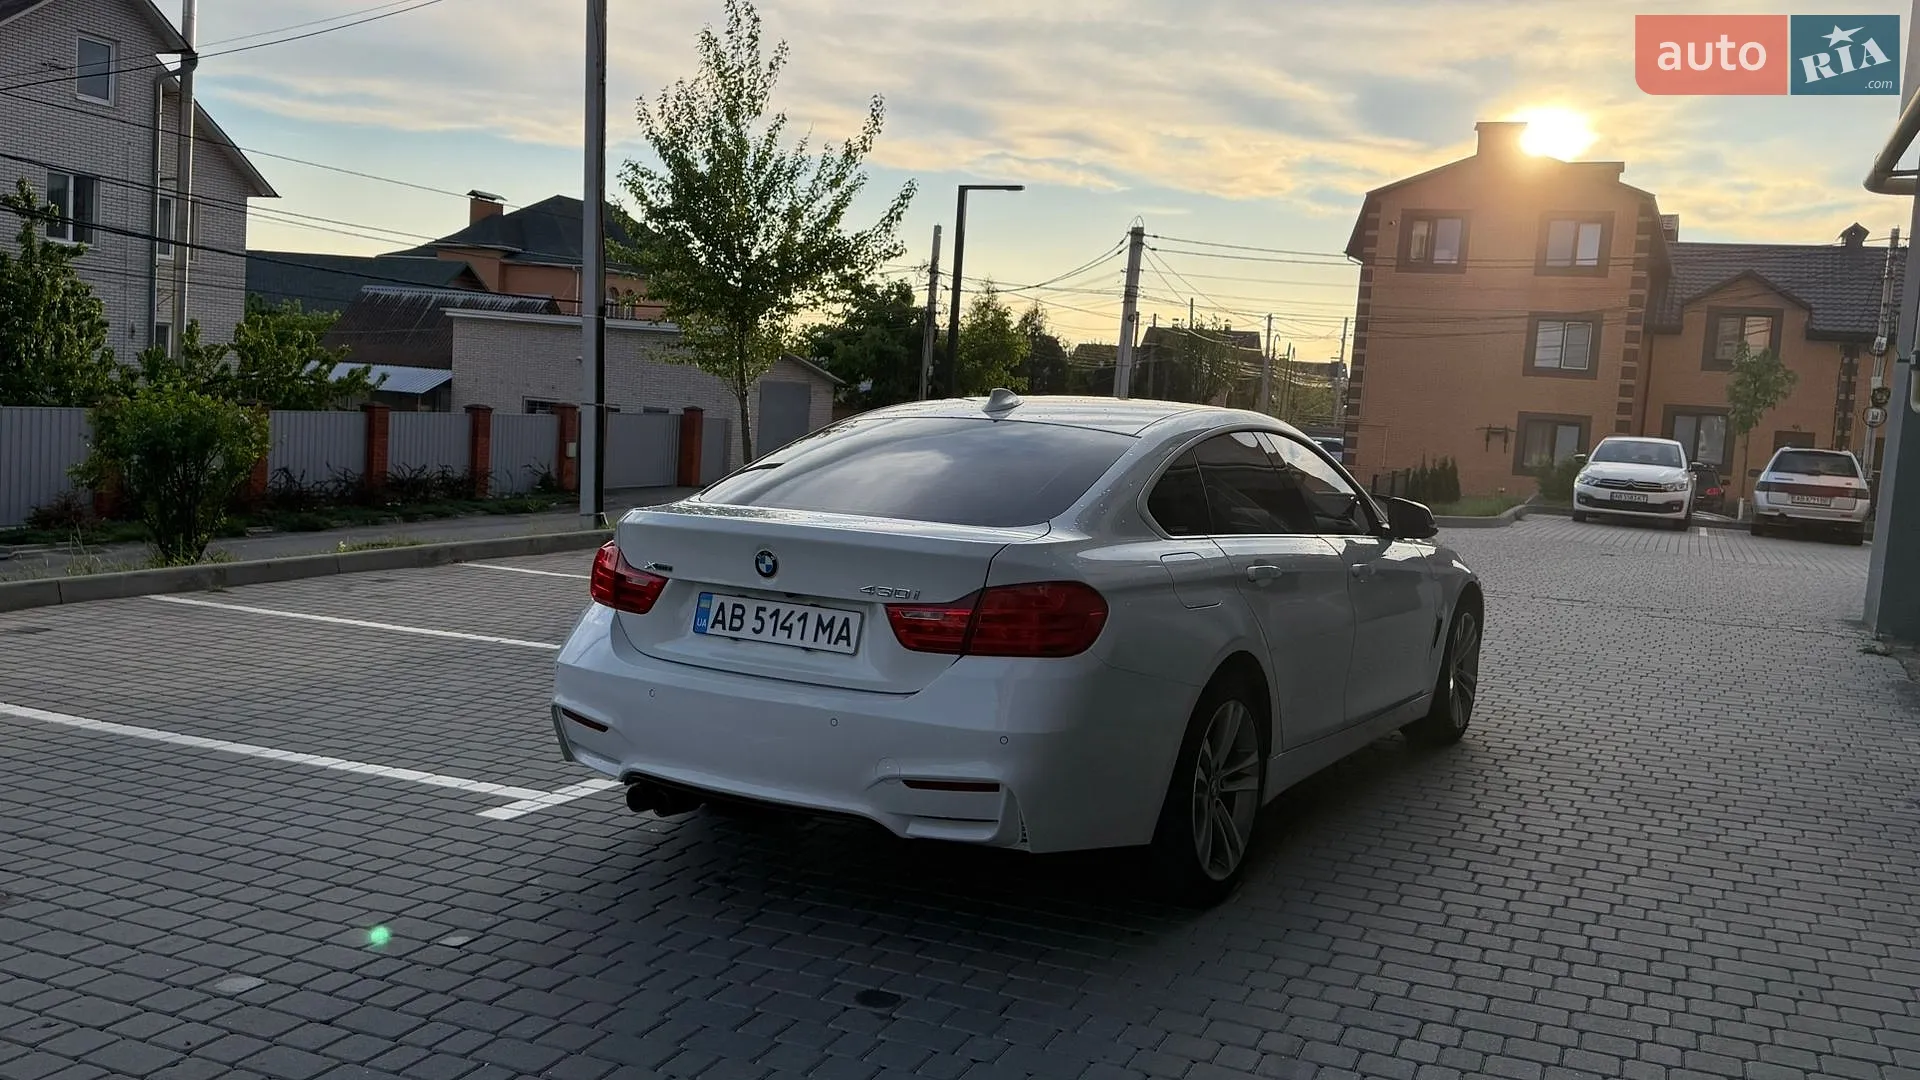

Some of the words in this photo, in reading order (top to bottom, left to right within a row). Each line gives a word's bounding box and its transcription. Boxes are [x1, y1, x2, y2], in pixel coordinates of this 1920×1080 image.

[859, 585, 921, 600] 430i
[696, 617, 707, 628] UA
[710, 601, 746, 632] AB
[751, 606, 809, 641] 5141
[813, 613, 851, 647] MA
